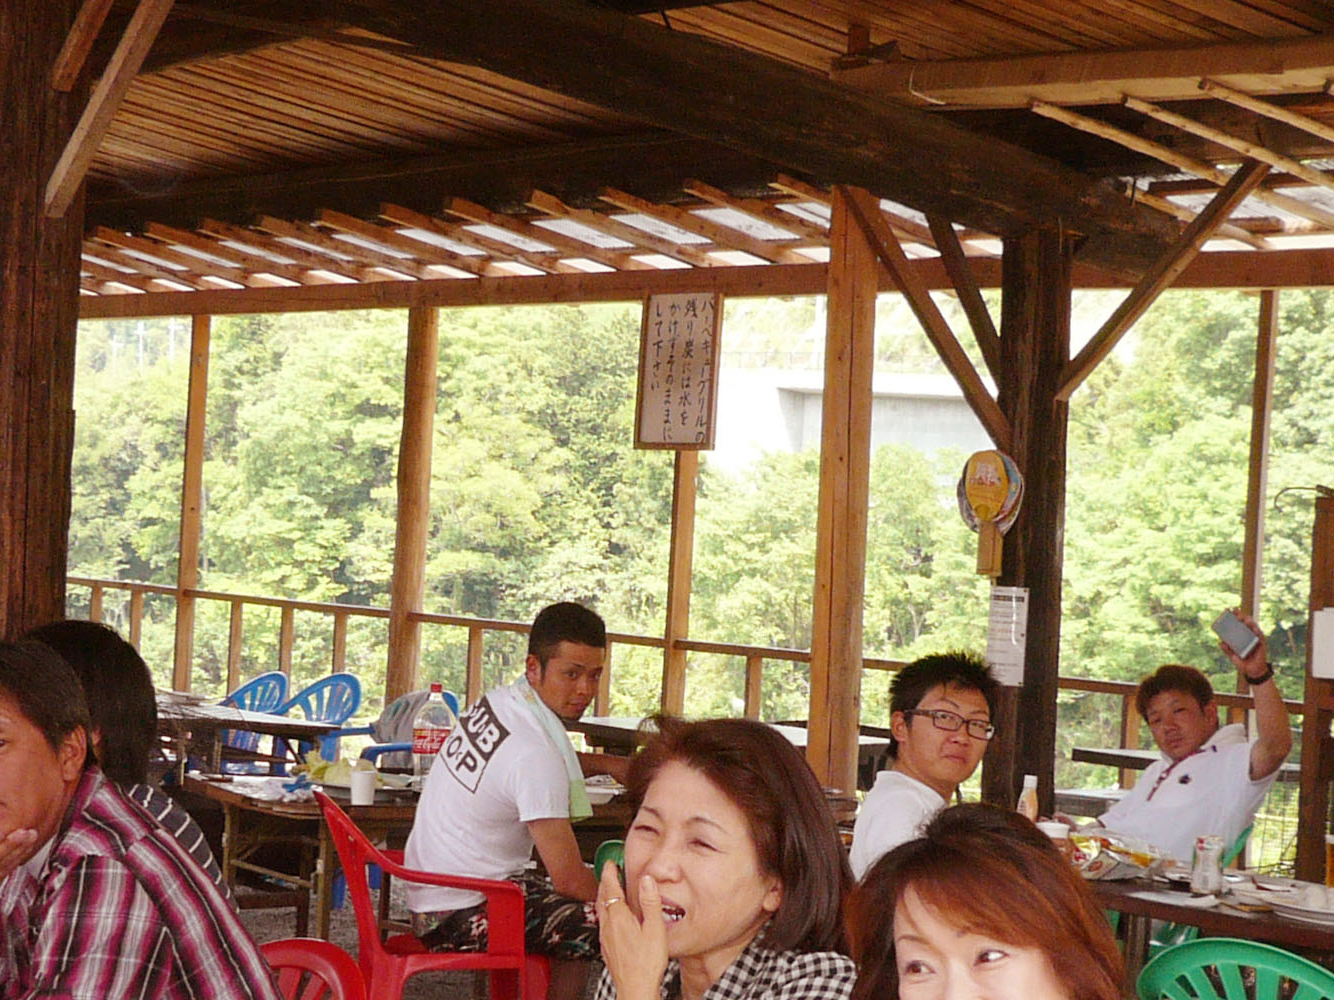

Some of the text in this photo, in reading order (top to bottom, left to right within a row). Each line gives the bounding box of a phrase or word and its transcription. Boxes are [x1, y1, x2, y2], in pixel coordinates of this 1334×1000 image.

[651, 301, 664, 392] して下さい
[678, 298, 698, 426] 残り炭には水を
[447, 735, 478, 773] OP
